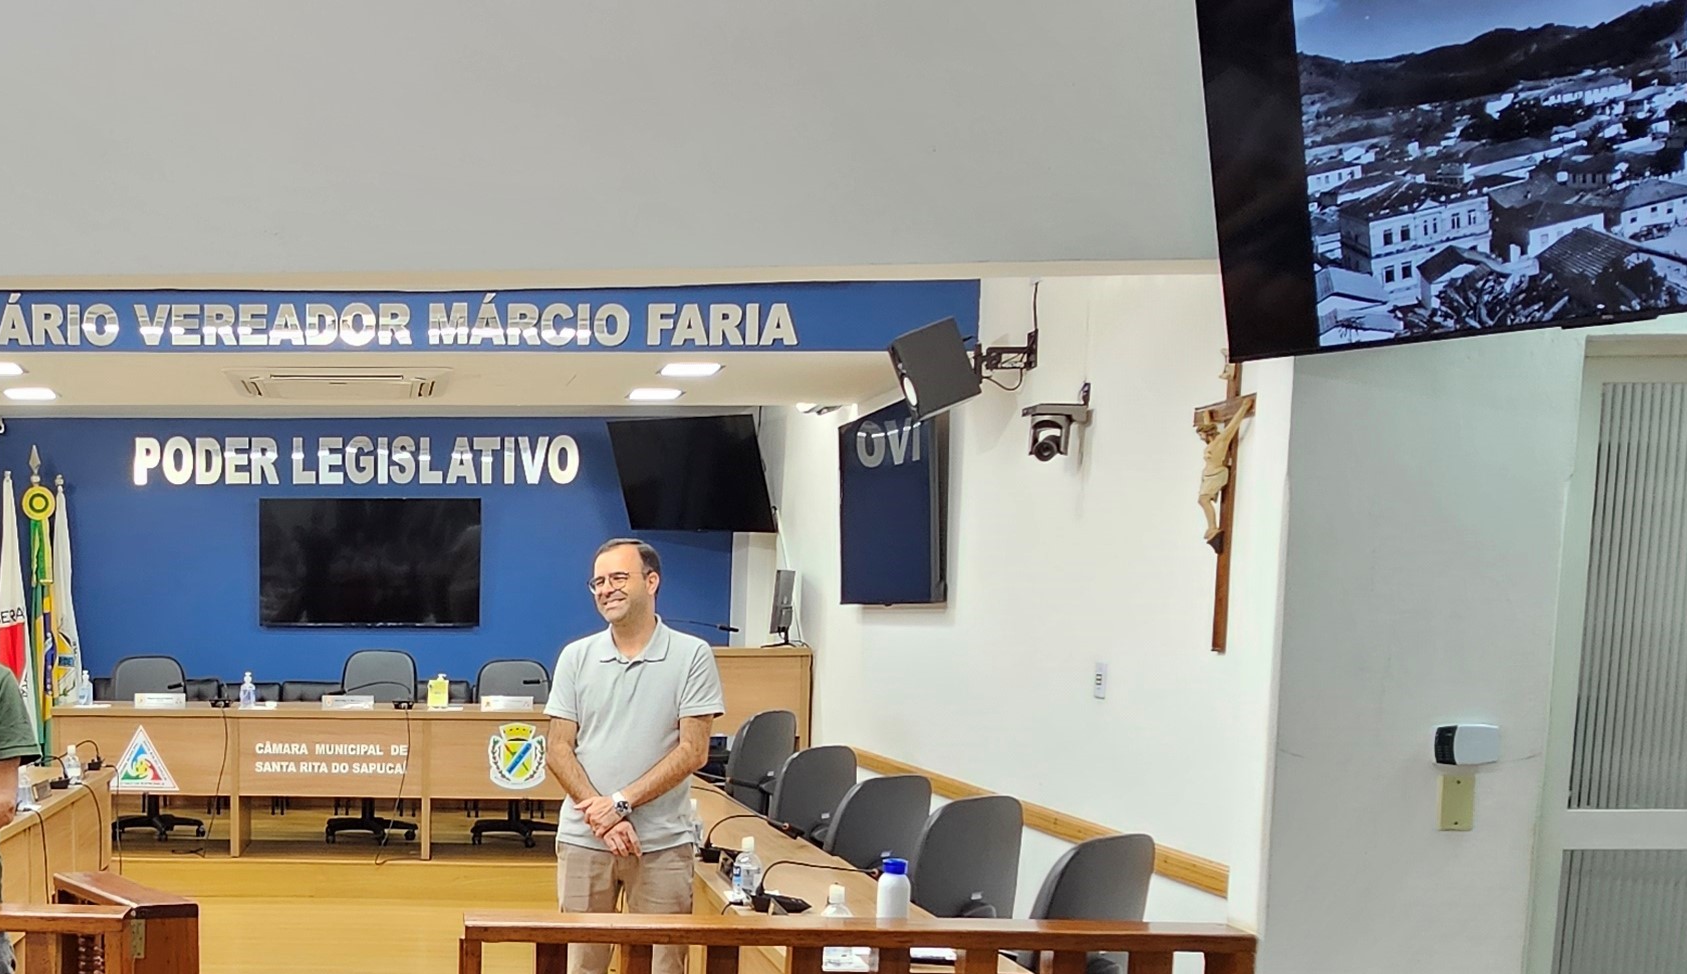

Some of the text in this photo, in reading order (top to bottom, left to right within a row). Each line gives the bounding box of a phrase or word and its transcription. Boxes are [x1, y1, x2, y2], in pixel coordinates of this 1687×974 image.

[134, 302, 412, 347] VEREADOR
[428, 293, 630, 347] MÁRCIO
[646, 302, 799, 347] FARIA
[133, 435, 580, 486] PODER LEGISLATIVO
[255, 740, 408, 756] CÂMARA MUNICIPAL DE
[254, 761, 297, 773] SANTA
[299, 761, 328, 774] RITA
[331, 762, 349, 774] DO
